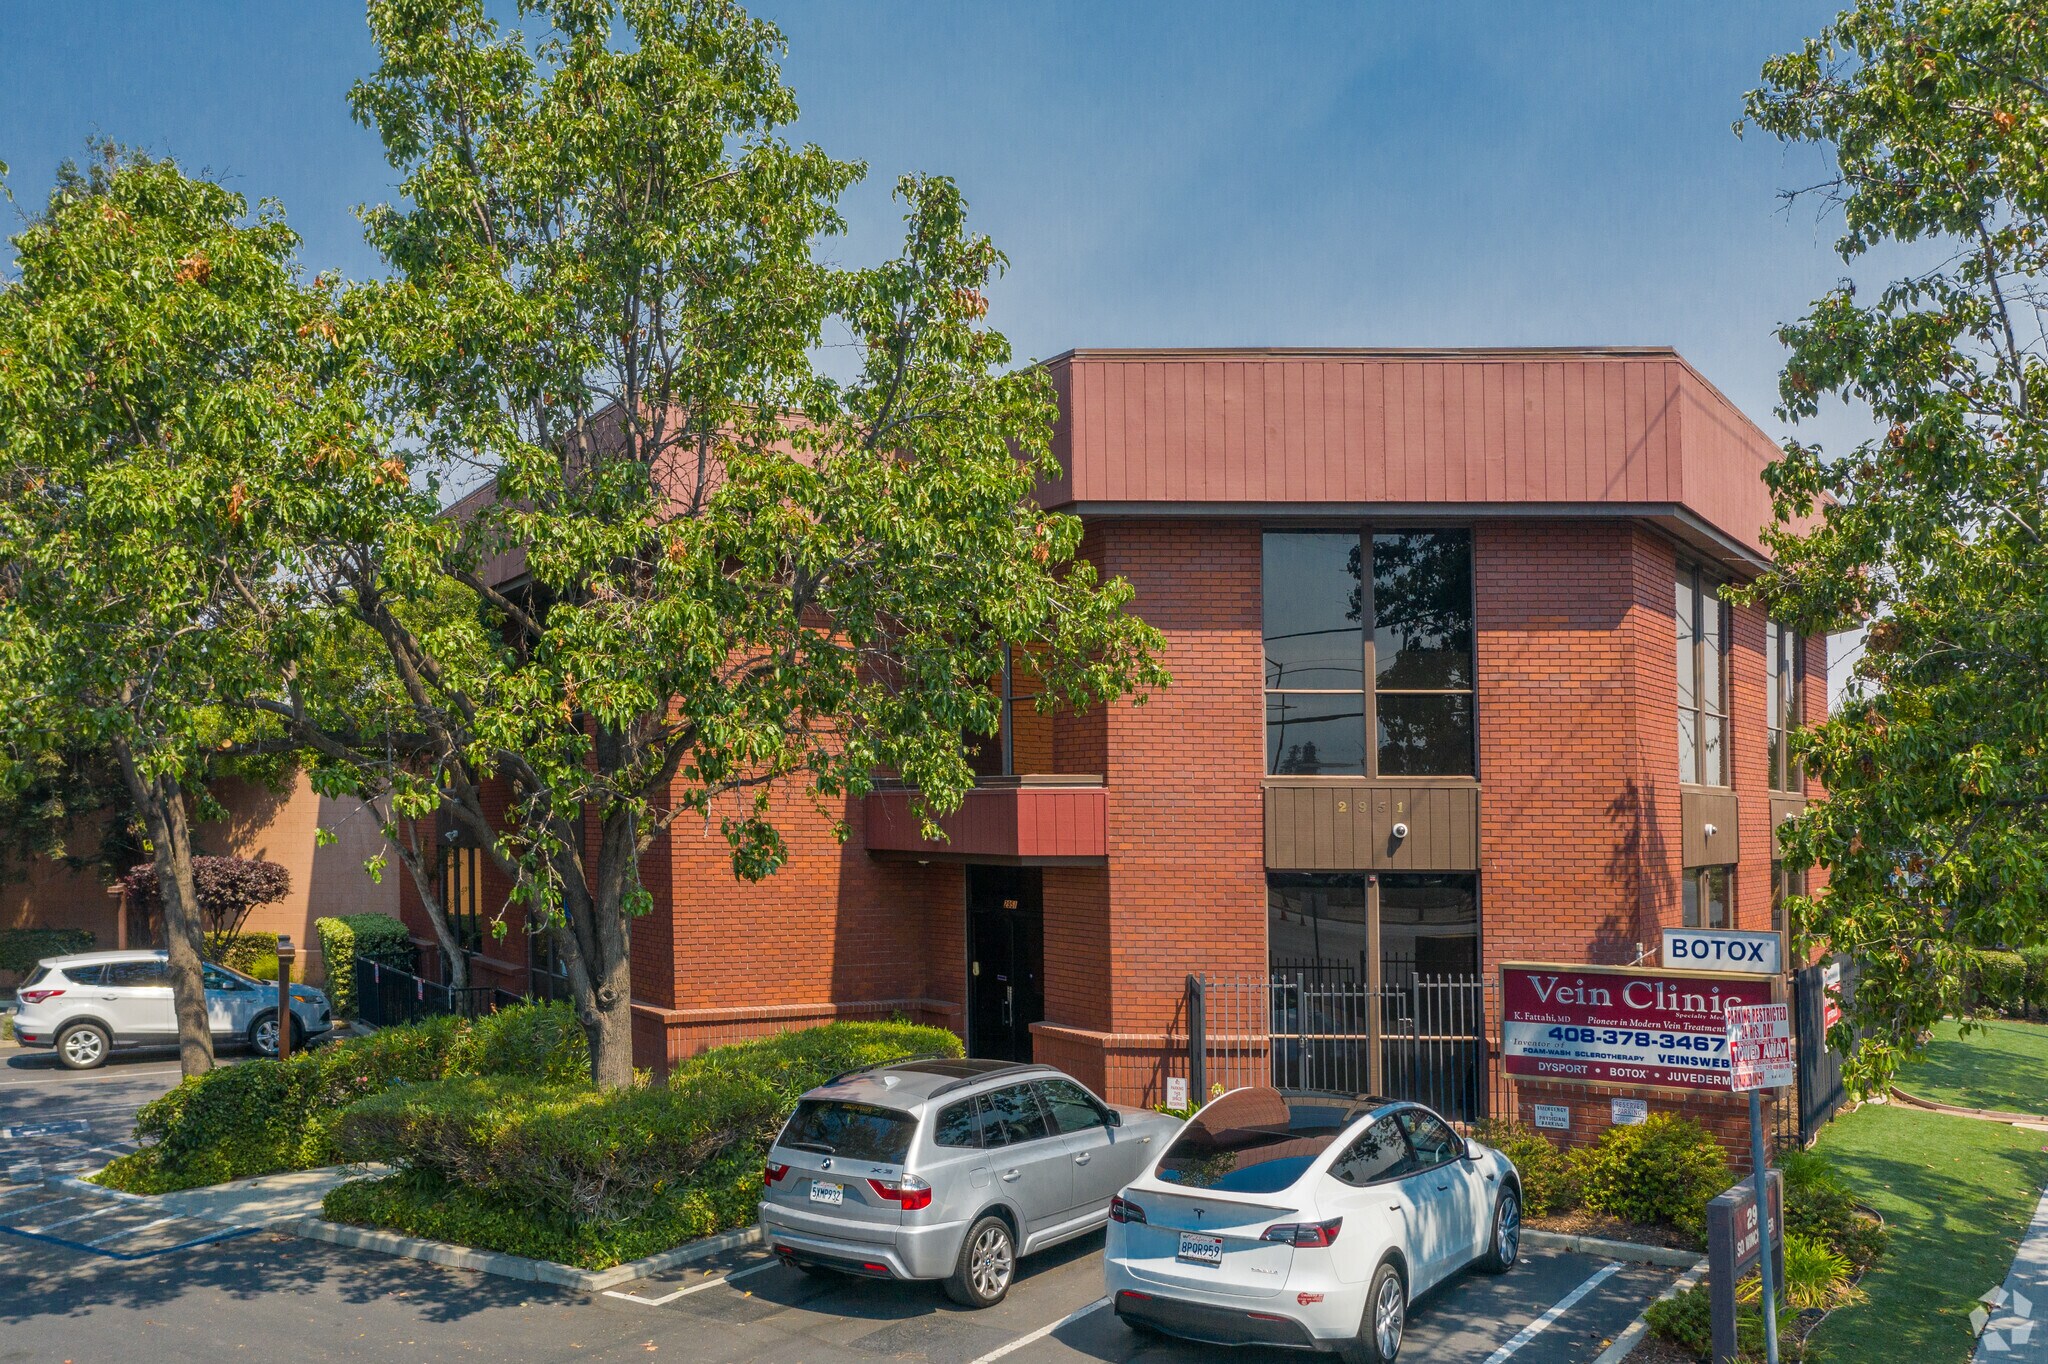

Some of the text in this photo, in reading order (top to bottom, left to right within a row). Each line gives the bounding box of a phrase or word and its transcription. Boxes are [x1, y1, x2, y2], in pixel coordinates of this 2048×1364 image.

[1338, 801, 1403, 813] 2951
[1527, 975, 1613, 1006] Vein
[1514, 1011, 1523, 1020] K.
[1524, 1012, 1556, 1022] Fattahi,
[1675, 1012, 1707, 1020] Specialty
[1727, 1006, 1787, 1025] PARKING RESTRICTED
[1587, 1016, 1618, 1026] Pioneer
[1629, 1019, 1661, 1028] Modern
[1663, 1021, 1681, 1030] Vein
[1683, 1022, 1727, 1032] Treatment
[1741, 1025, 1748, 1039] 24
[1763, 1023, 1774, 1037] DAY
[1513, 1038, 1551, 1047] Inventor
[1548, 1027, 1726, 1052] 408-378-3467
[1523, 1047, 1644, 1061] FOAM-WASH SCLEROTHERAPY
[1732, 1044, 1760, 1061] TOWED
[1763, 1042, 1787, 1058] AWAY
[1538, 1062, 1588, 1074] DYSPORT
[1667, 1072, 1731, 1085] JUVEDERM
[1614, 1101, 1644, 1110] RESERVED
